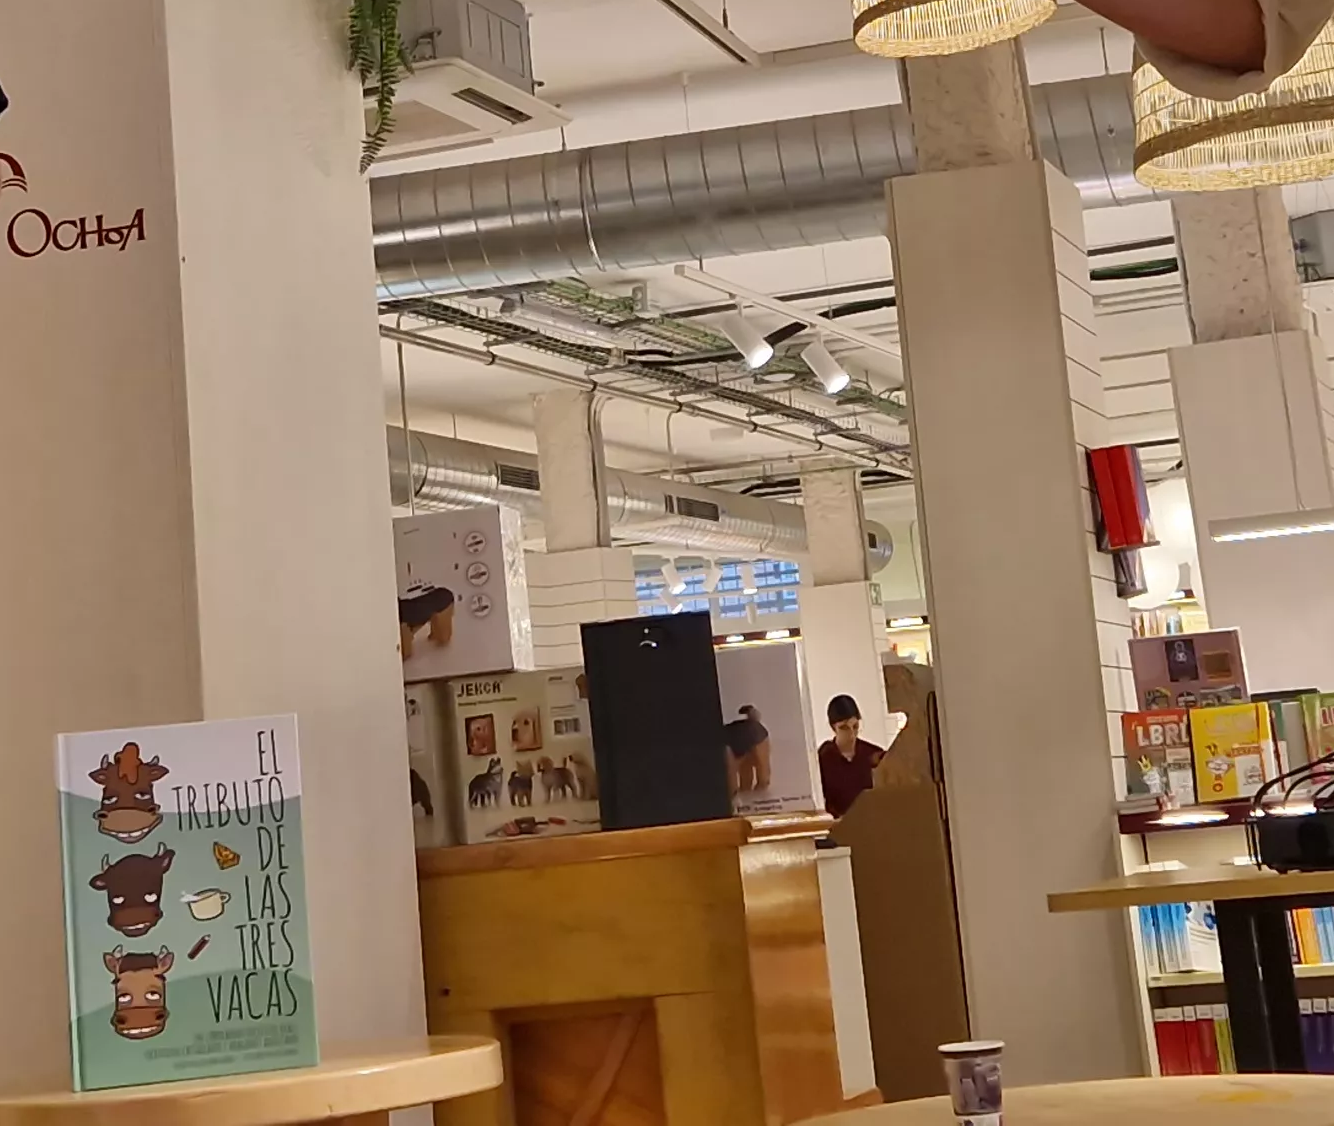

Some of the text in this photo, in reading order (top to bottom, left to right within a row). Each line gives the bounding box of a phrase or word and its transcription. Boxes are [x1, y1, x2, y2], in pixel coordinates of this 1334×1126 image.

[257, 729, 283, 776] EL
[172, 776, 285, 831] TRIBUTO
[258, 825, 289, 872] DE
[244, 871, 292, 922] LAS
[234, 920, 295, 972] TRES
[207, 968, 299, 1024] VACAS
